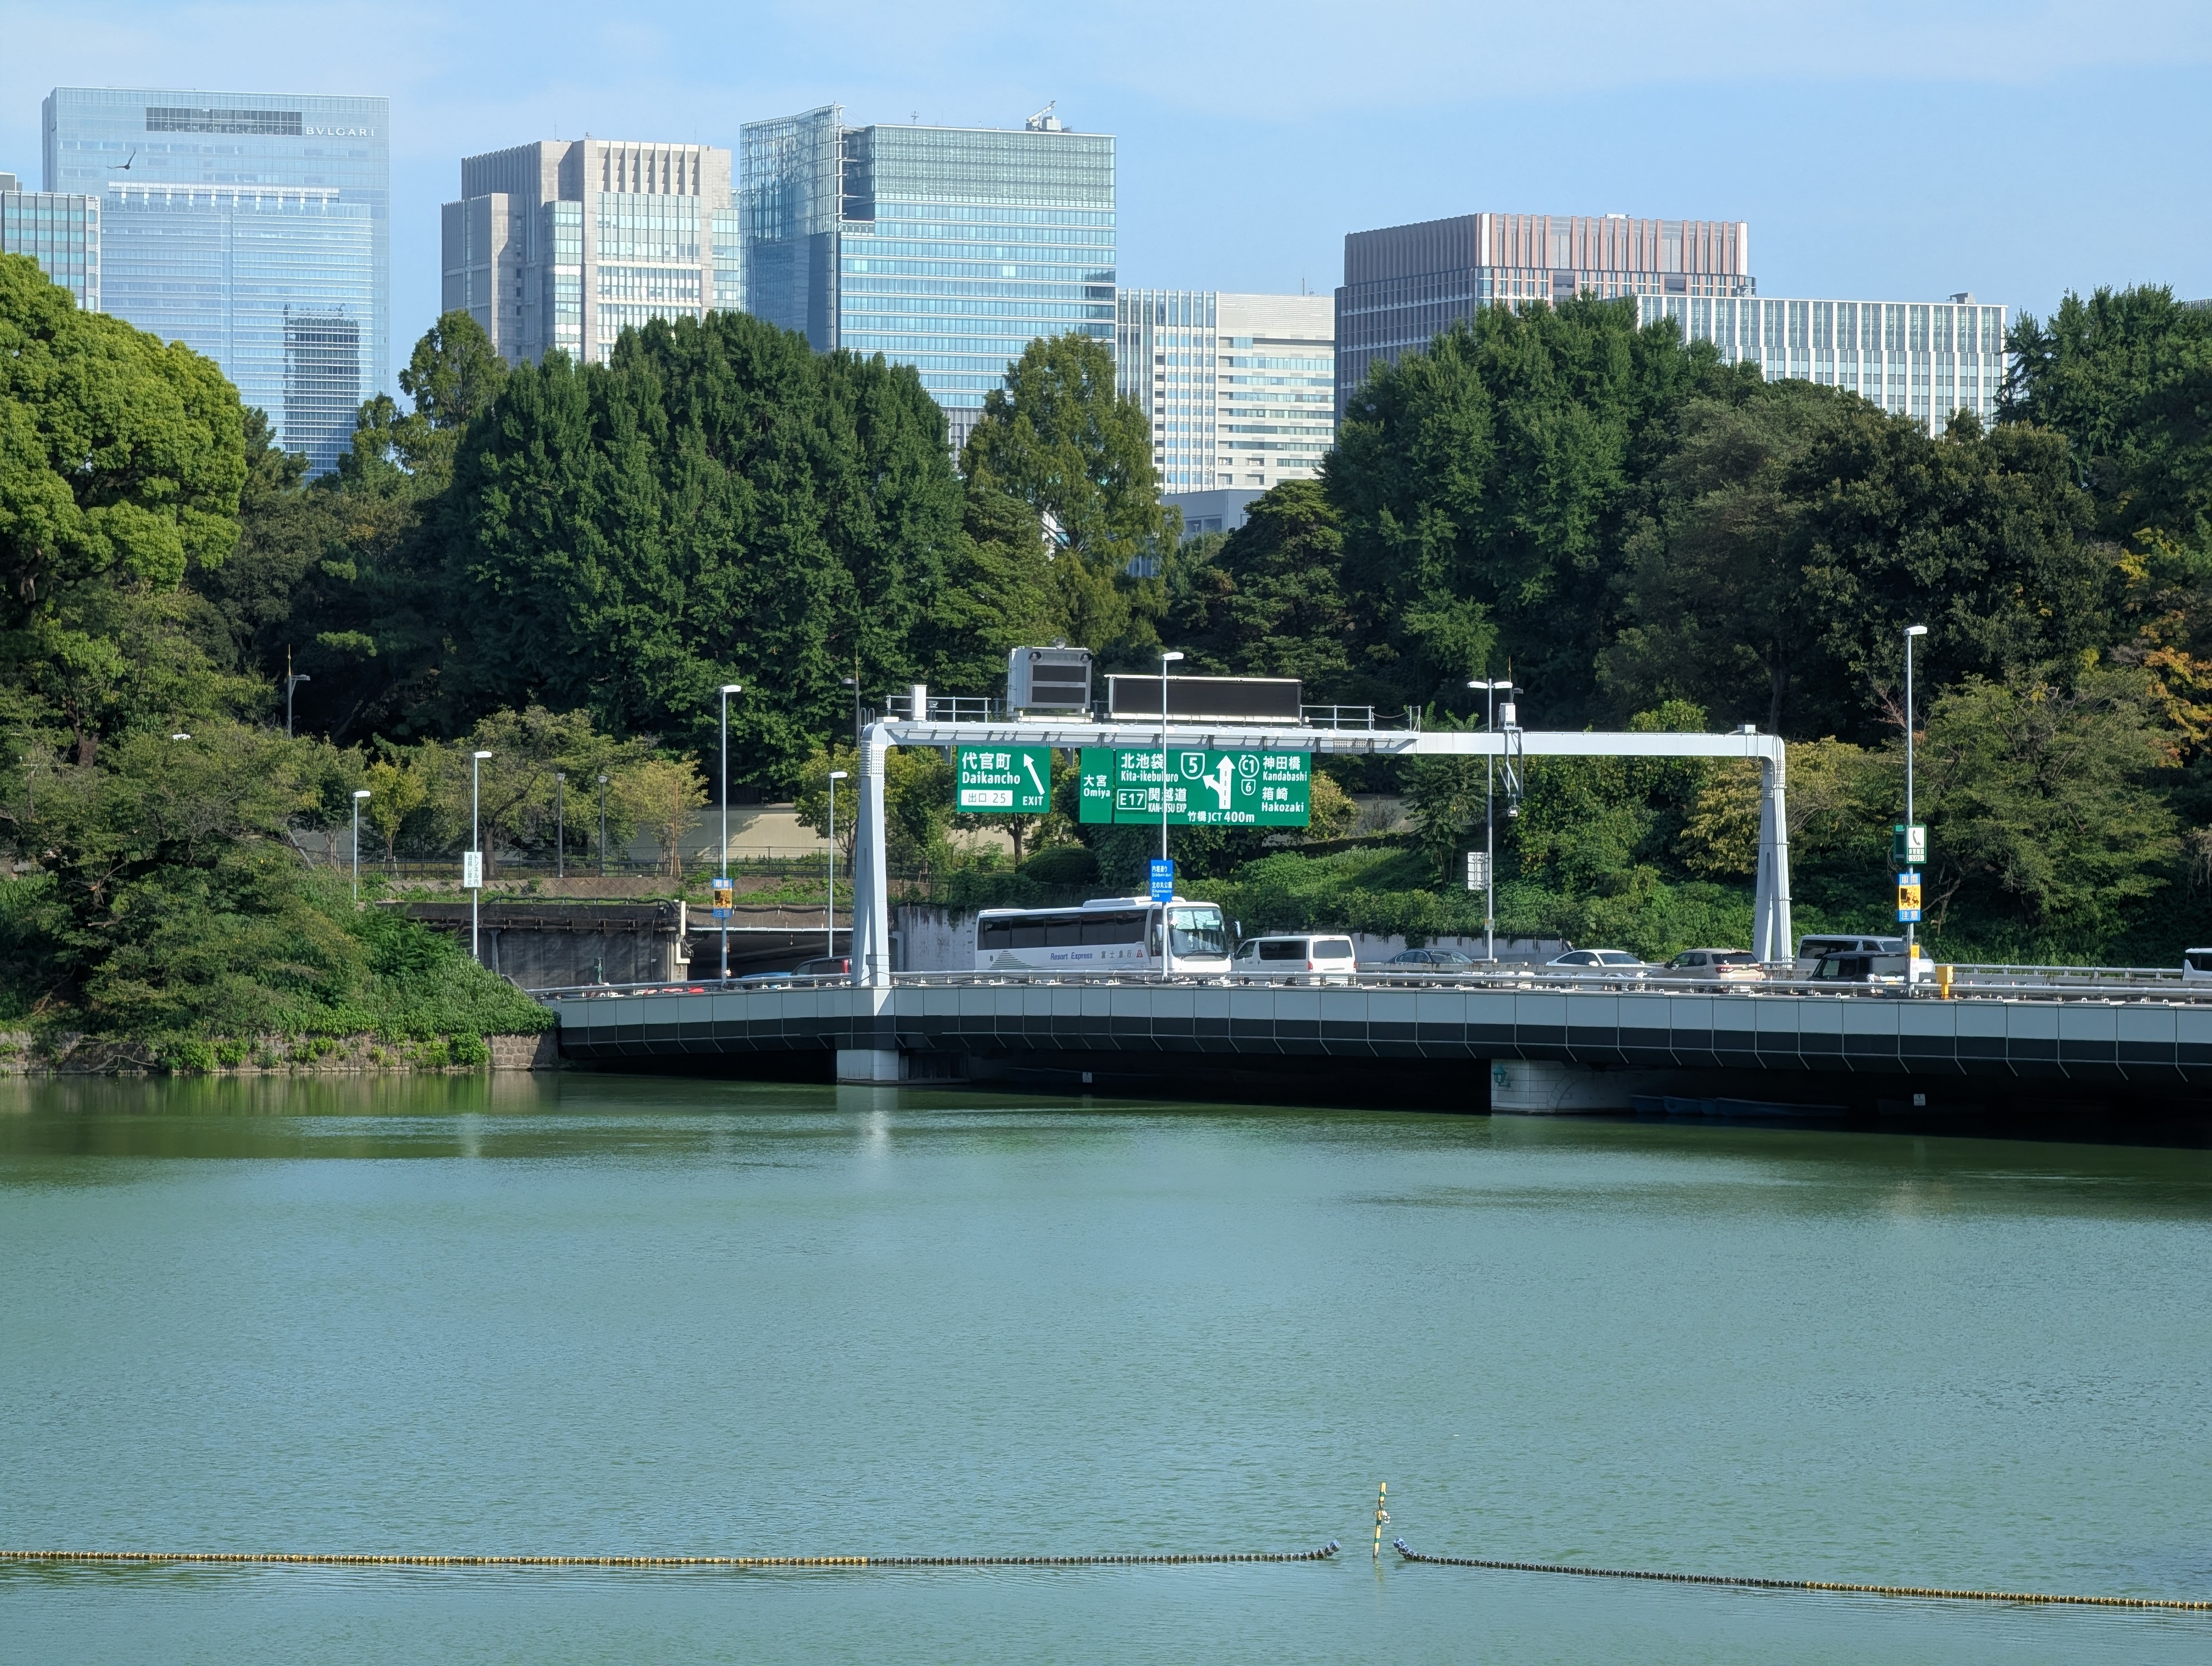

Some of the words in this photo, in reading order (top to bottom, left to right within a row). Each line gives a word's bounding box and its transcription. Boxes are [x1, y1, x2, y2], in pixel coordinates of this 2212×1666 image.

[306, 127, 374, 137] BVLGARI
[962, 752, 1012, 770] 代官町
[1121, 752, 1164, 770] 北池袋
[1188, 757, 1198, 773] 5
[1242, 759, 1254, 773] C1
[1263, 755, 1301, 771] 神田橋
[962, 771, 1020, 785] Daikancho
[1083, 774, 1107, 787] 大宮
[1263, 771, 1308, 781] Kandabashi
[1245, 781, 1252, 792] 6
[968, 792, 987, 803] 出口
[993, 793, 1006, 804] 25
[1083, 787, 1110, 799] Omiya
[1148, 787, 1187, 802] 関越道
[1262, 786, 1288, 801] 箱崎
[1023, 796, 1044, 806] EXIT
[1120, 793, 1144, 806] E17
[1176, 803, 1187, 813] EXP
[1262, 802, 1304, 812] Hakozaki
[1224, 811, 1255, 823] 400m
[1050, 952, 1068, 960] Resort
[1071, 951, 1093, 961] Express
